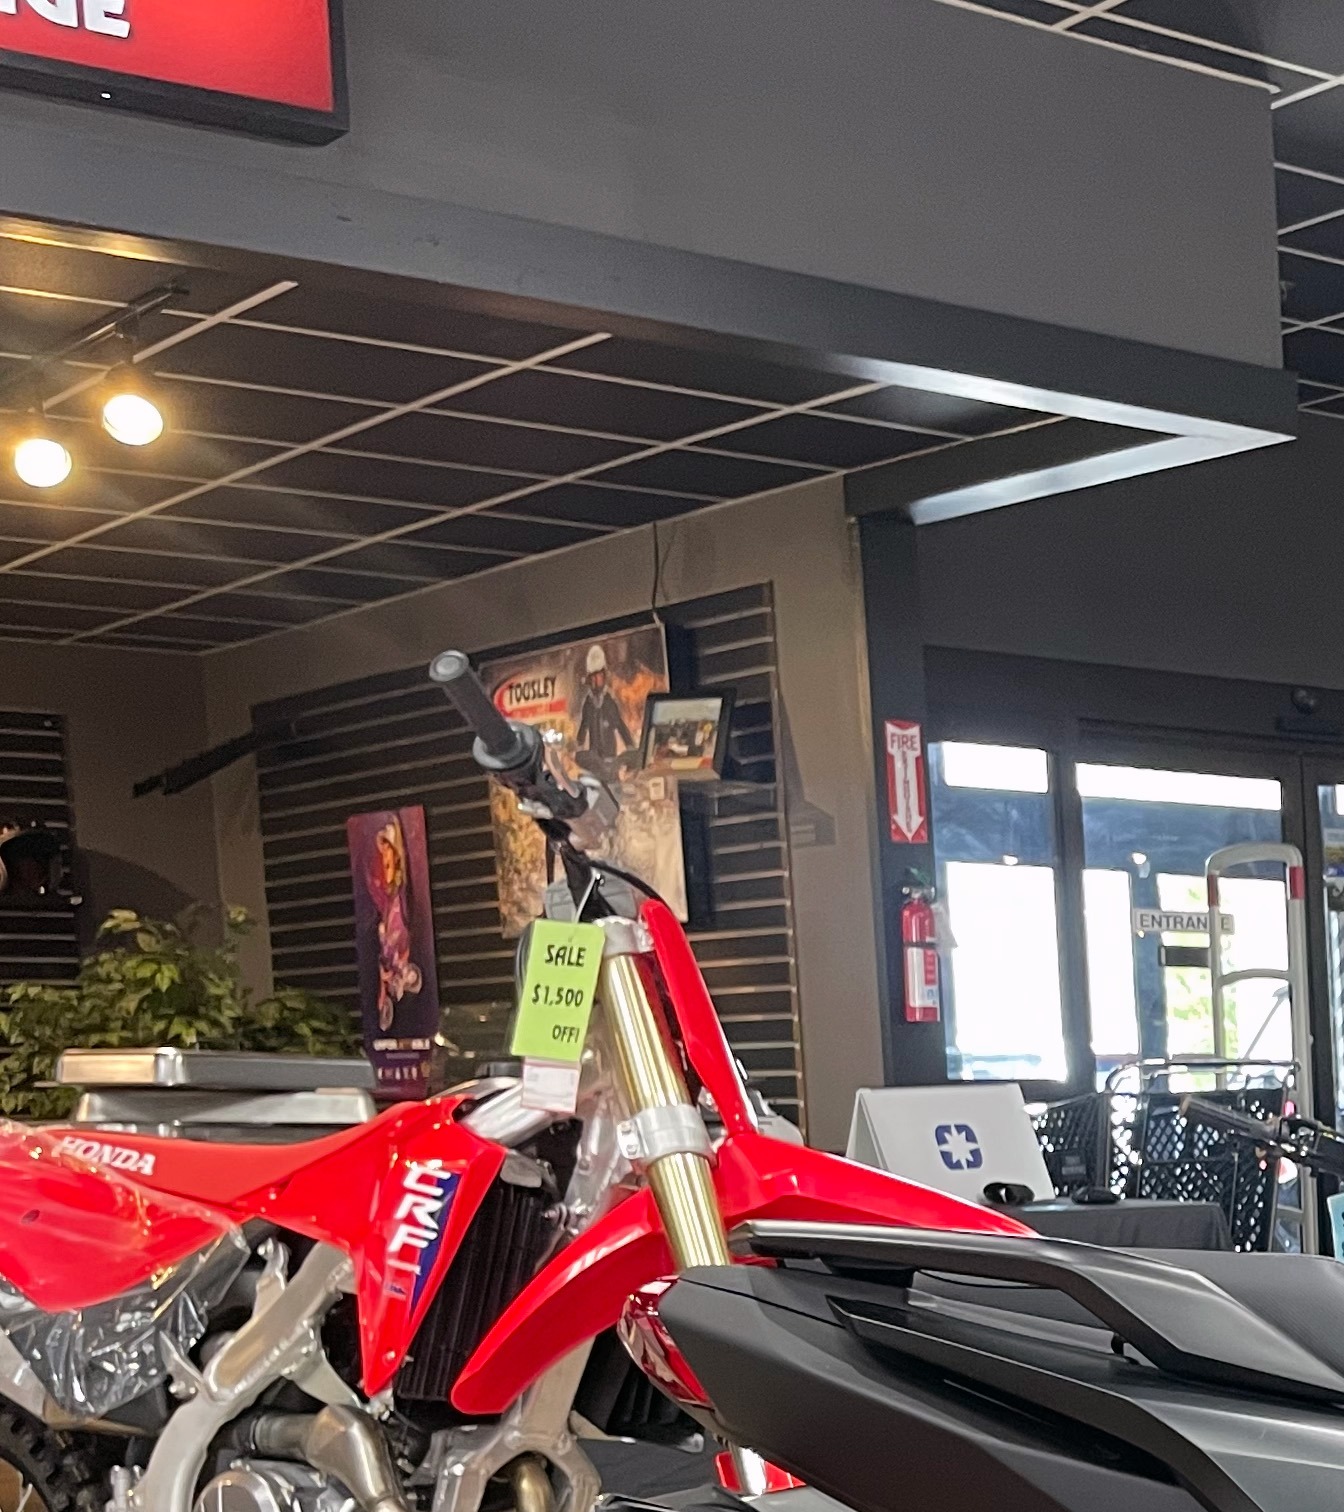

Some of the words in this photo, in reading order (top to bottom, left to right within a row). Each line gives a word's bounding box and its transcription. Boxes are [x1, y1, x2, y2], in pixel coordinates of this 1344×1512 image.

[508, 676, 557, 705] TOUSLEY
[890, 733, 919, 752] FIRE
[1140, 914, 1231, 931] ENTRANE
[545, 944, 587, 967] SALE
[532, 983, 584, 1008] $1,500
[52, 1136, 156, 1176] HONDA
